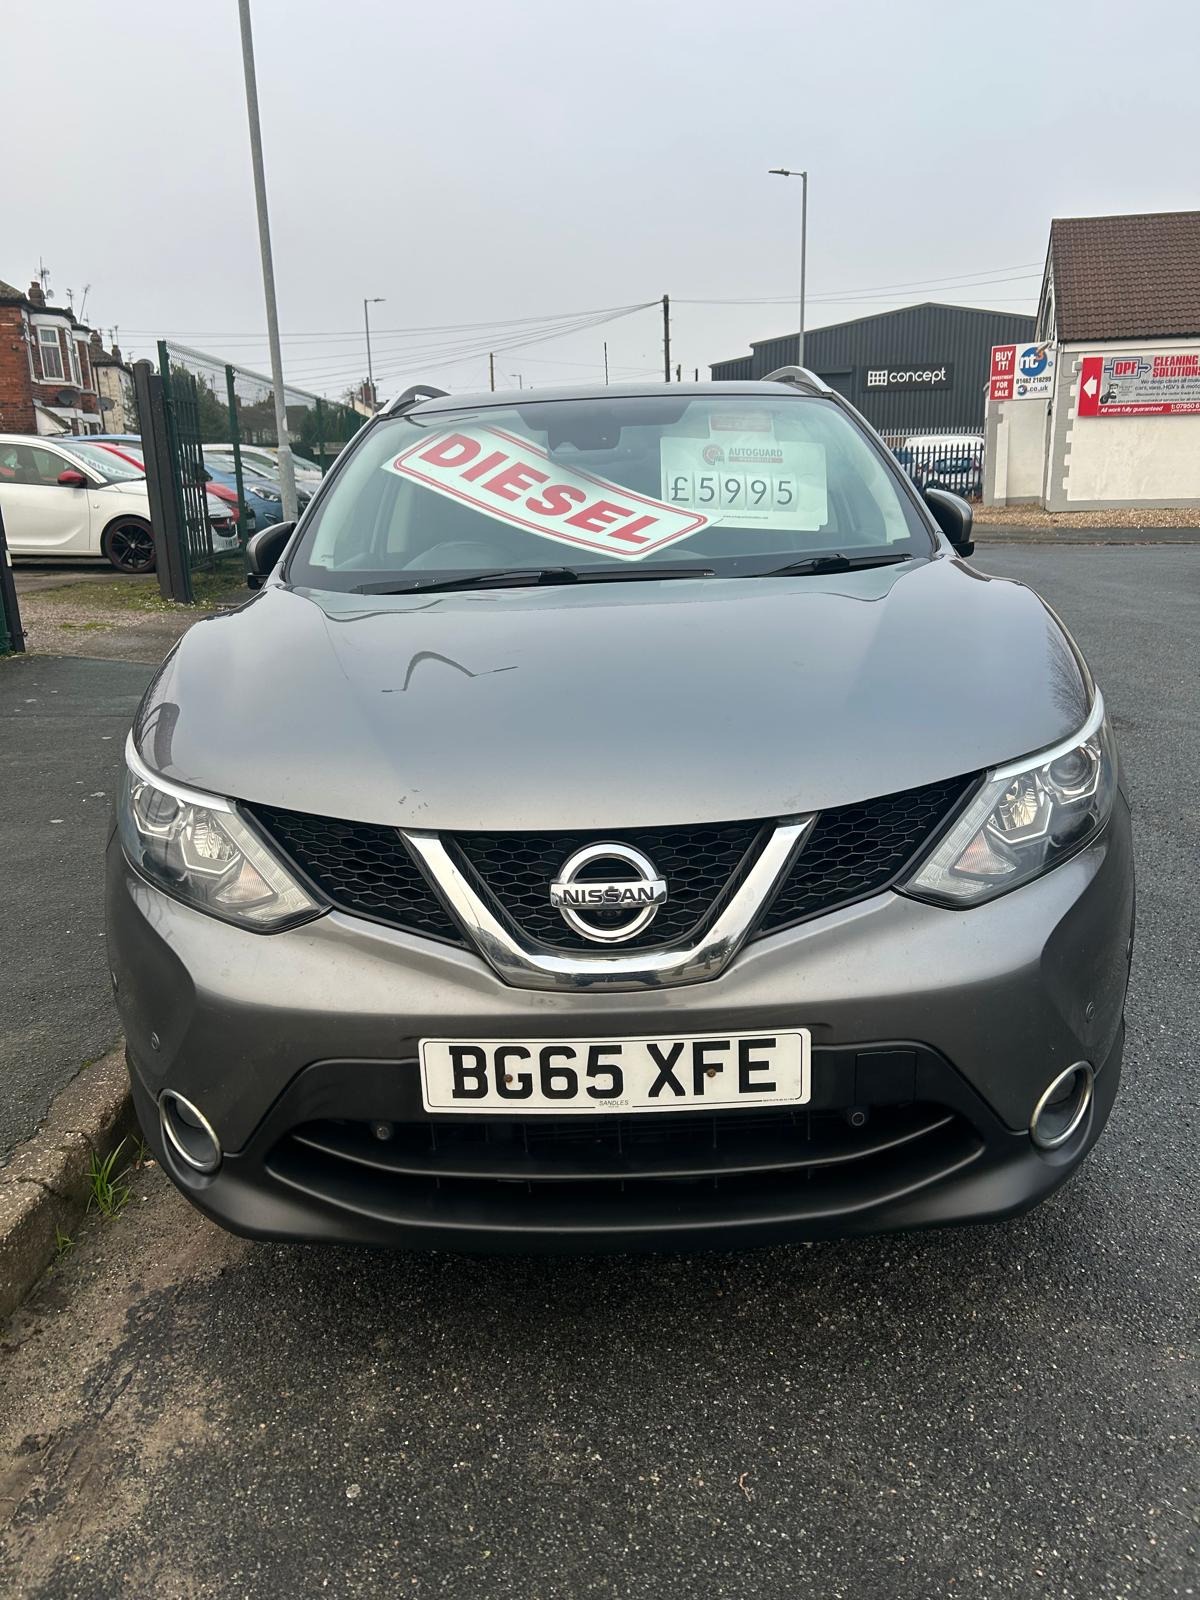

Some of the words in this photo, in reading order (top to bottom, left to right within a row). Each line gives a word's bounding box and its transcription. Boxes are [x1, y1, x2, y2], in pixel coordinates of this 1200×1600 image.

[995, 351, 1013, 361] BUY
[1154, 356, 1199, 366] CLEANING
[998, 361, 1009, 371] IT!
[1115, 361, 1137, 375] DPF
[889, 367, 946, 384] concept
[994, 389, 1009, 397] SALE
[728, 447, 783, 457] AUTOGUARD
[418, 432, 660, 544] DIESEL
[671, 476, 793, 505] £5995
[563, 886, 654, 904] NISSAN
[449, 1044, 623, 1100] BG65
[646, 1038, 777, 1098] XFE
